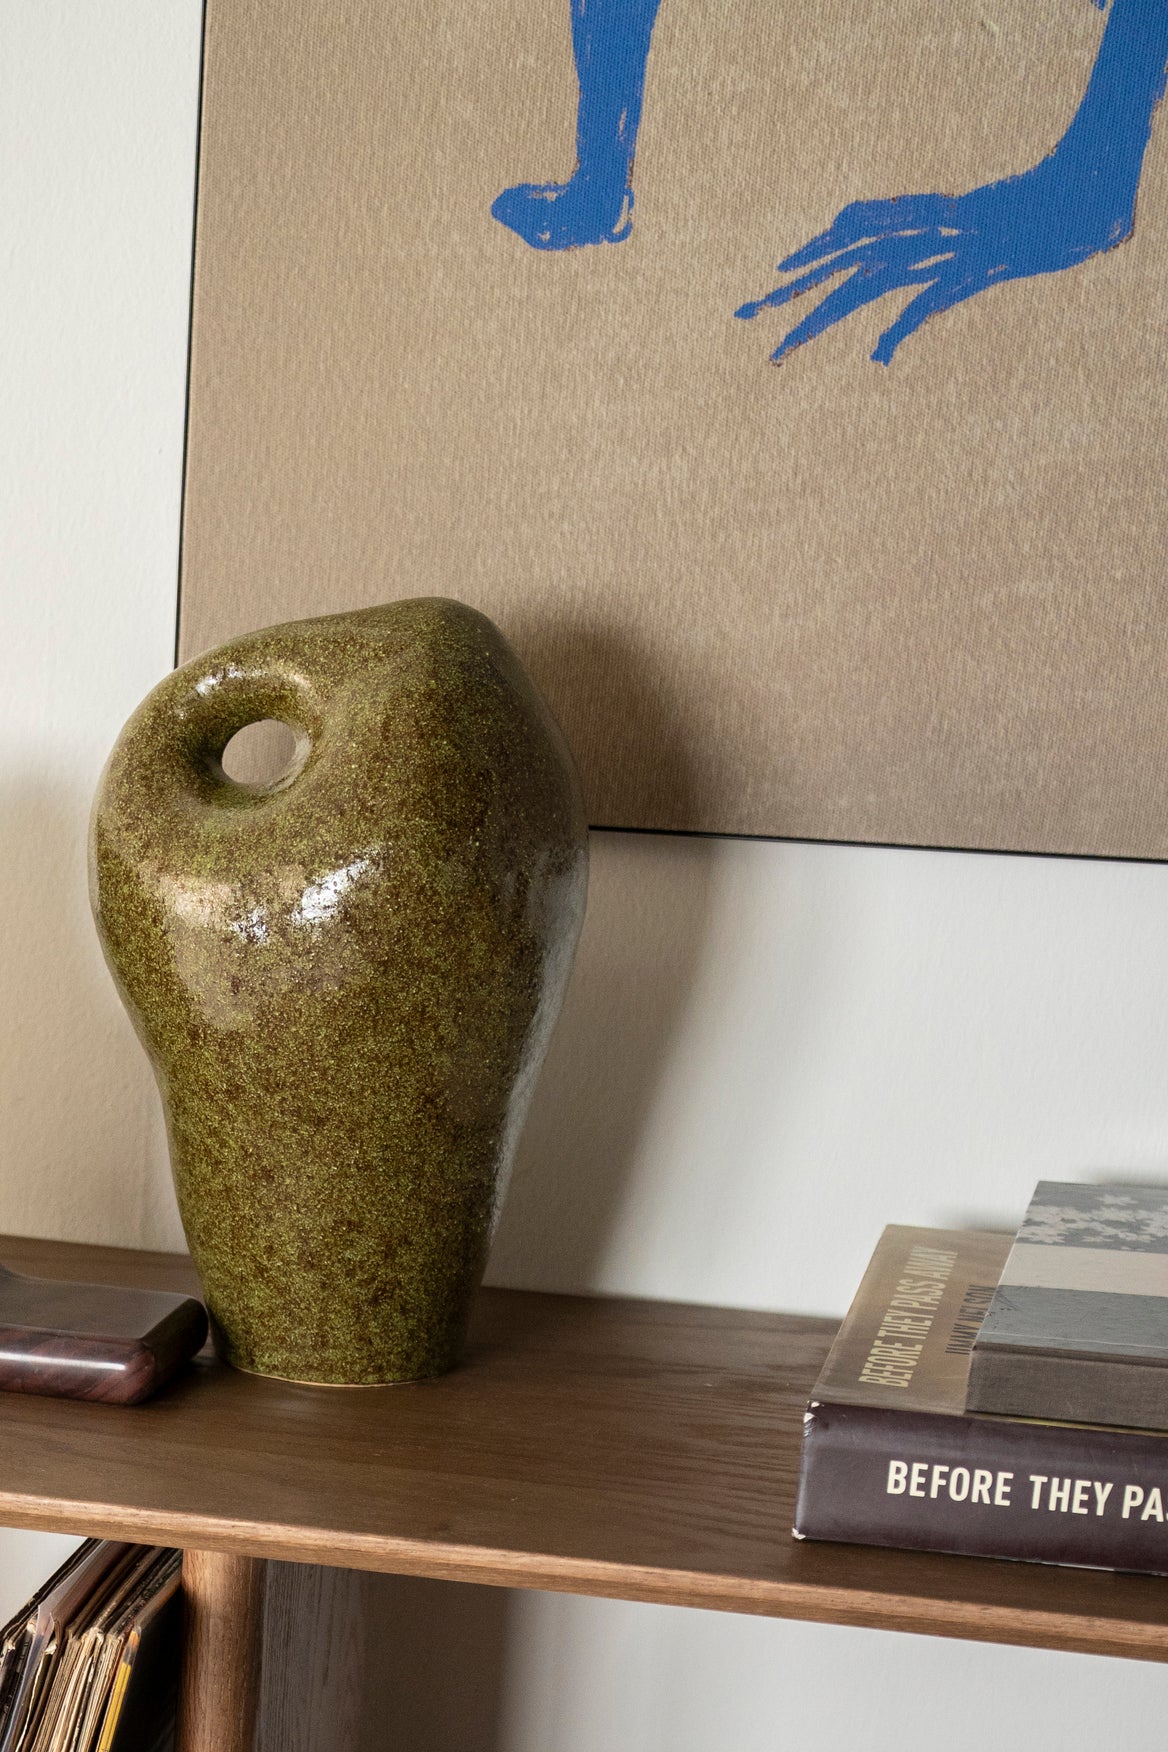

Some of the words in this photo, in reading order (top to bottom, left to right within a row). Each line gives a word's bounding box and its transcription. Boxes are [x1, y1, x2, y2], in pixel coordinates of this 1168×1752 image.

[904, 1246, 958, 1280] AWAY
[890, 1279, 946, 1311] PASS
[877, 1309, 934, 1339] THEY
[858, 1340, 924, 1388] BEFORE
[886, 1460, 1014, 1507] BEFORE
[1029, 1475, 1114, 1518] THEY
[1122, 1485, 1168, 1523] PA
